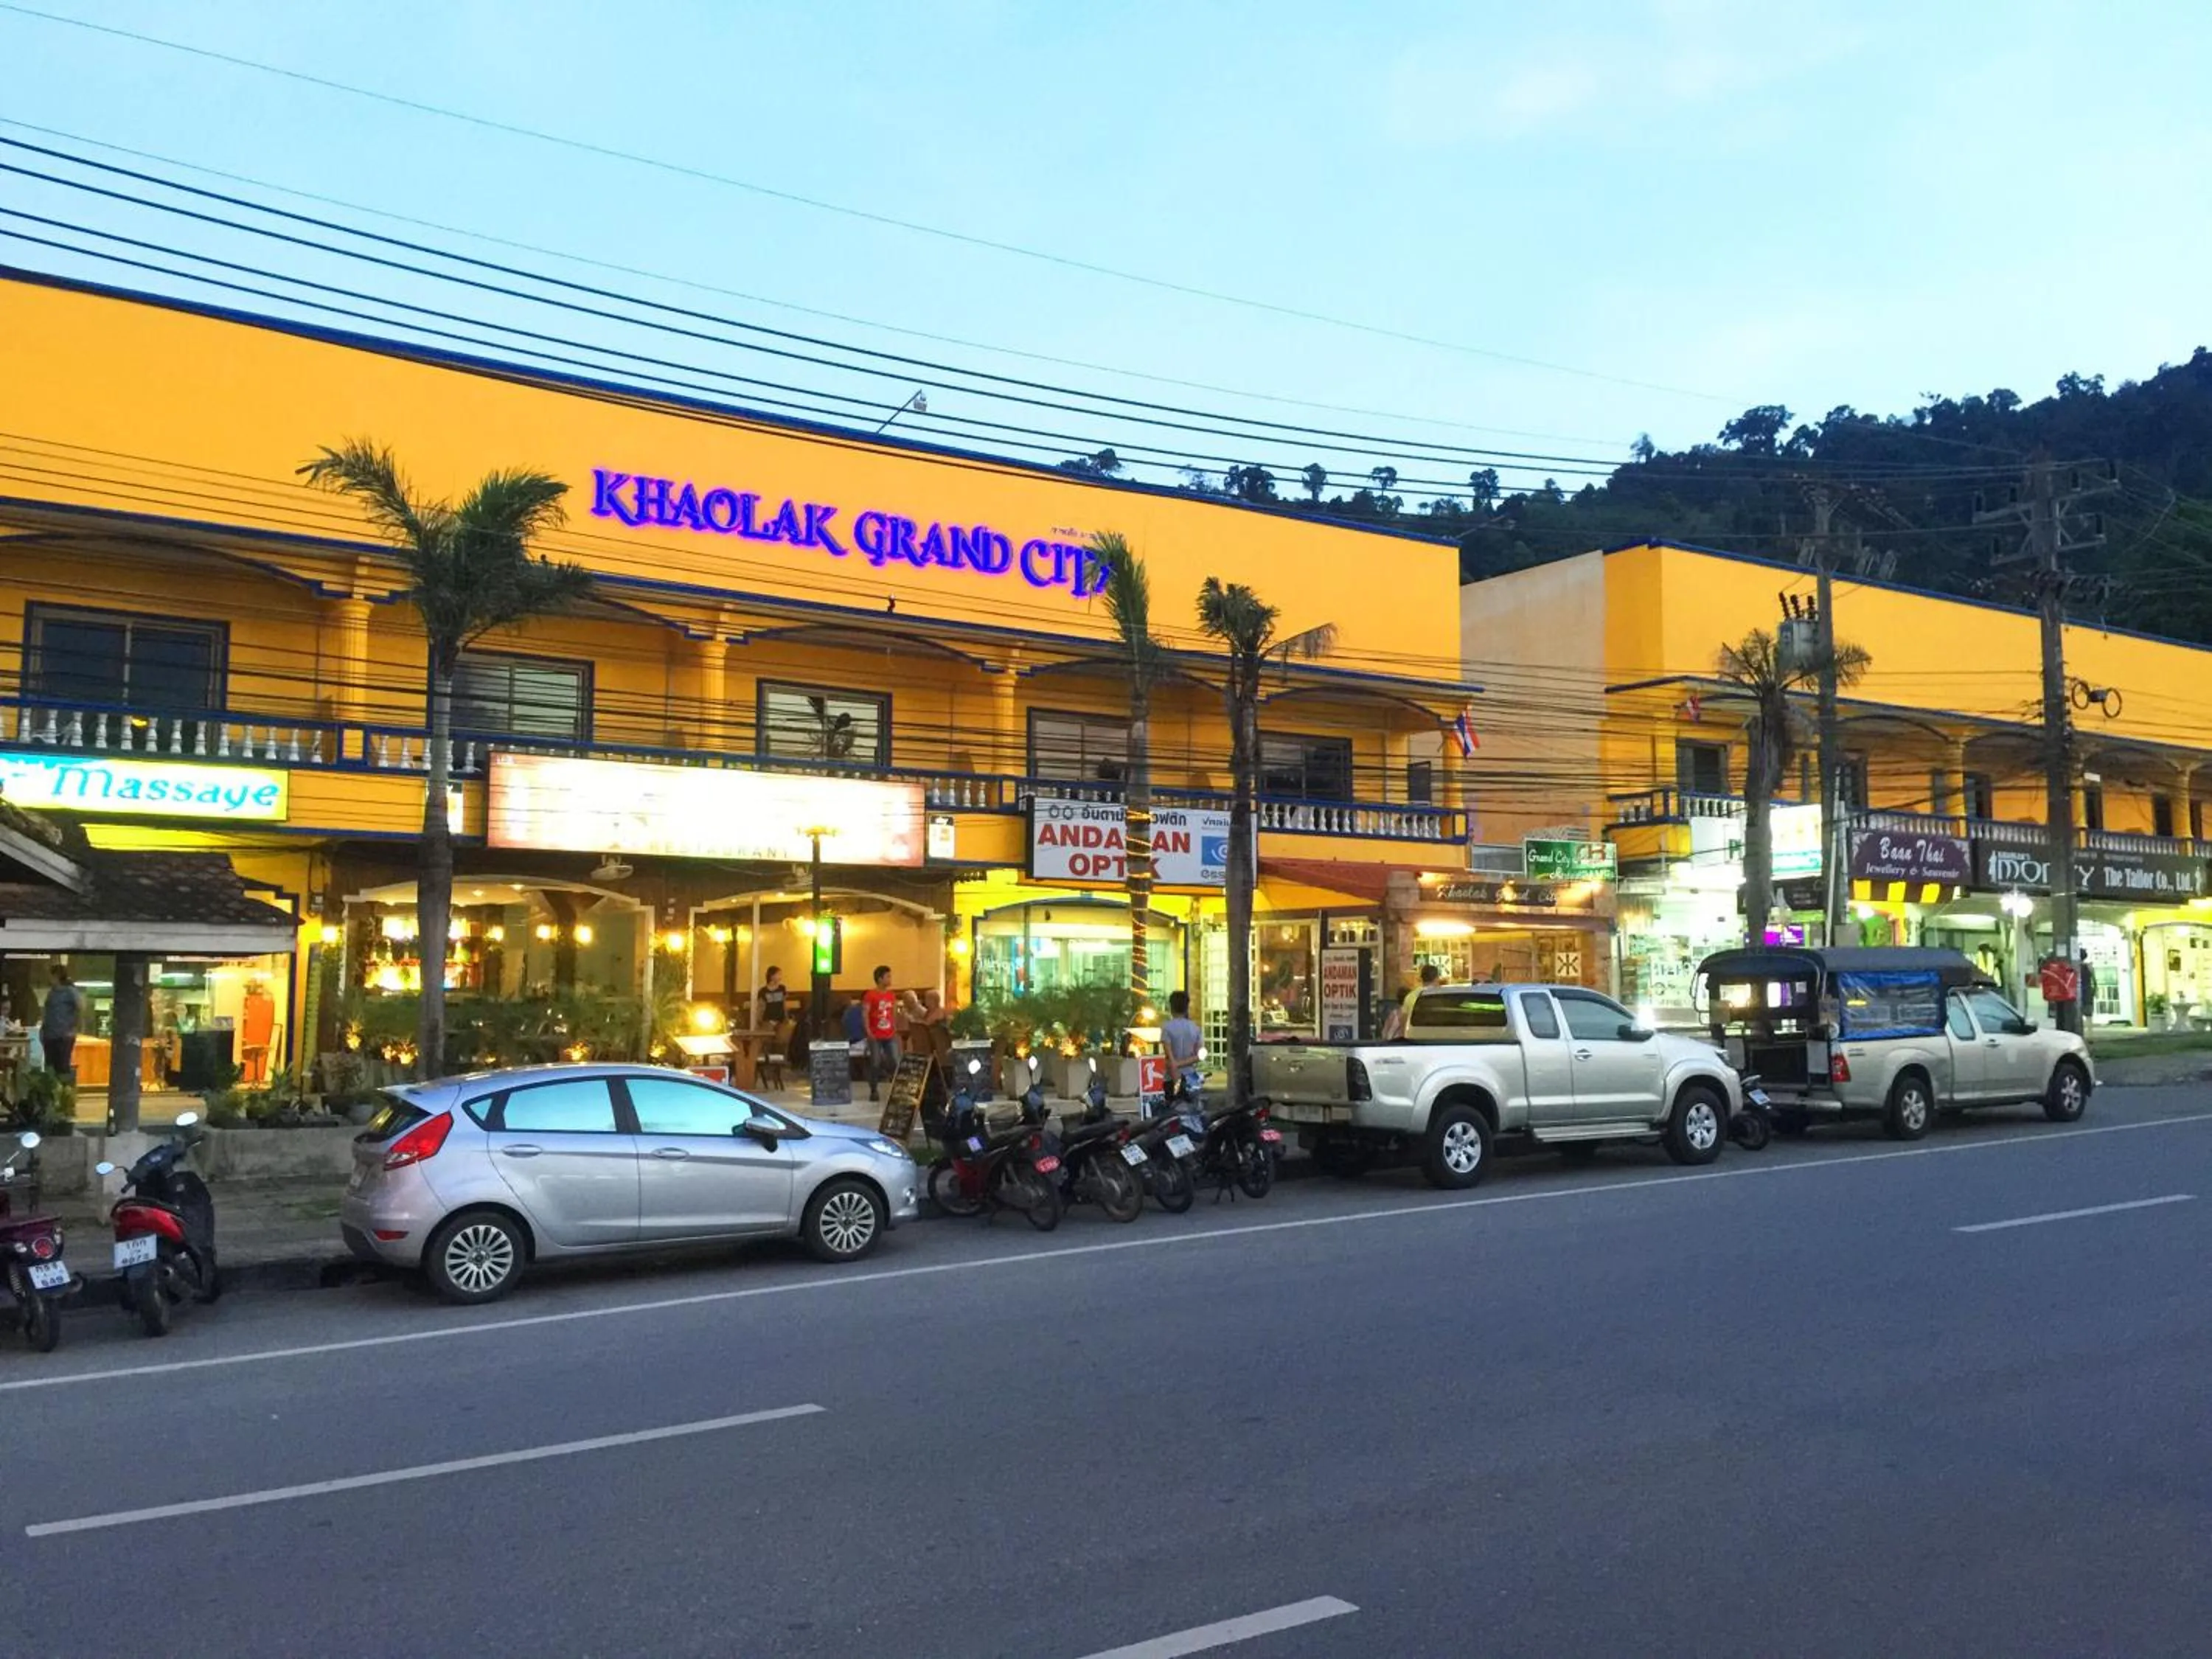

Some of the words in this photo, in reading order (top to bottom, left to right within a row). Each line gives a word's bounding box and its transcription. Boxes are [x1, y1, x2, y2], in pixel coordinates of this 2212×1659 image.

[591, 468, 849, 557] KHAOLAK
[853, 510, 1013, 574] GRAND
[1037, 823, 1191, 854] ANDAAN
[1879, 836, 1912, 861] Baan
[1916, 838, 1945, 863] Thai
[1069, 852, 1162, 880] OPTK
[2104, 866, 2124, 887] The
[1324, 965, 1357, 980] ANDAMAN
[1324, 983, 1357, 998] OPTIK
